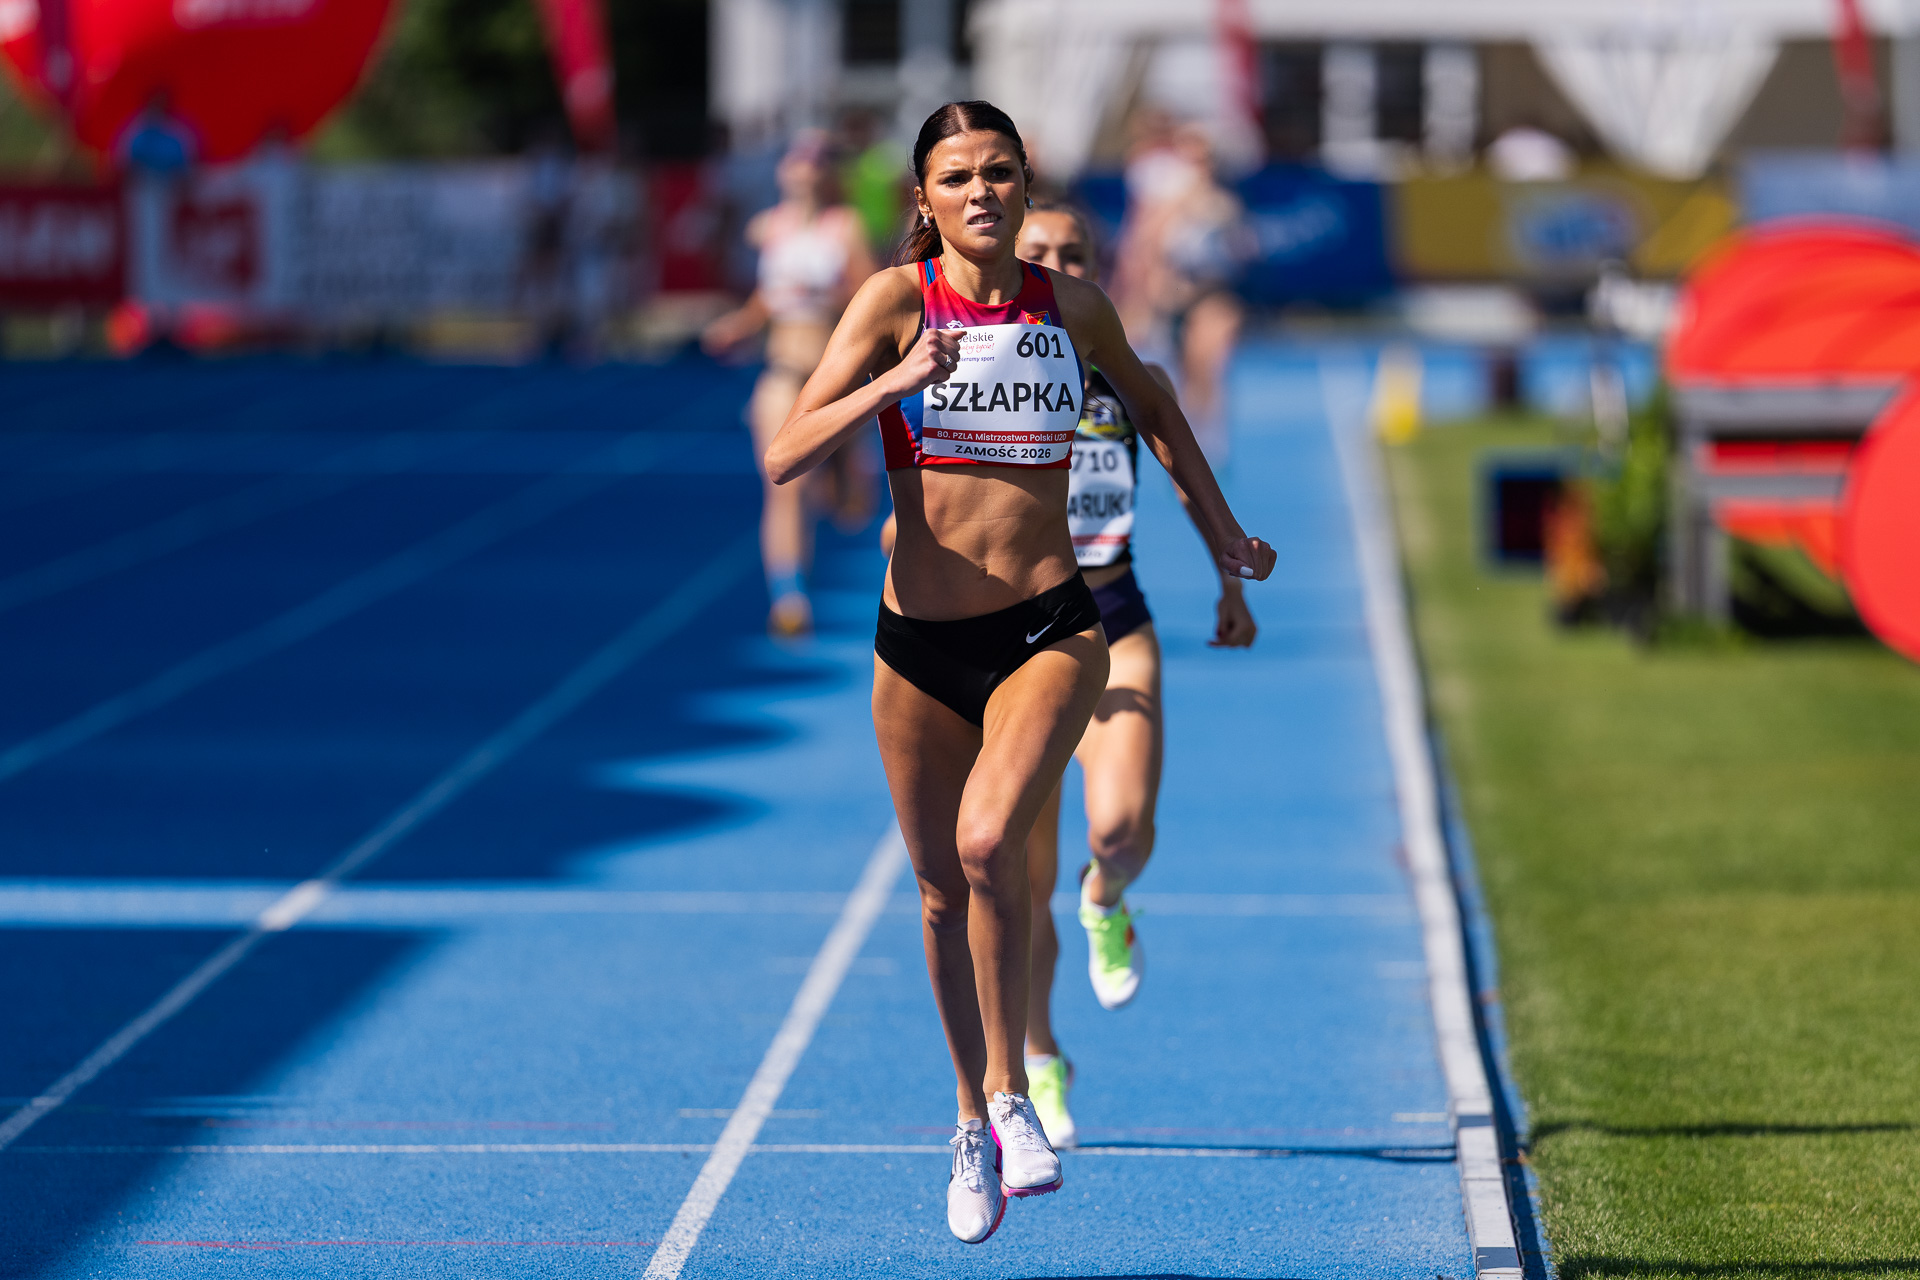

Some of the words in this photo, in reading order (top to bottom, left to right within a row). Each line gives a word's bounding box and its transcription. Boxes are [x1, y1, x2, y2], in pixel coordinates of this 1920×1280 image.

[1016, 332, 1065, 359] 601
[930, 382, 1075, 412] SZŁAPKA
[975, 433, 1028, 442] Mistrzostwa
[1030, 433, 1053, 442] Polski
[1054, 433, 1067, 441] U20
[955, 445, 1017, 458] ZAMOŚĆ
[1020, 448, 1051, 459] 2026
